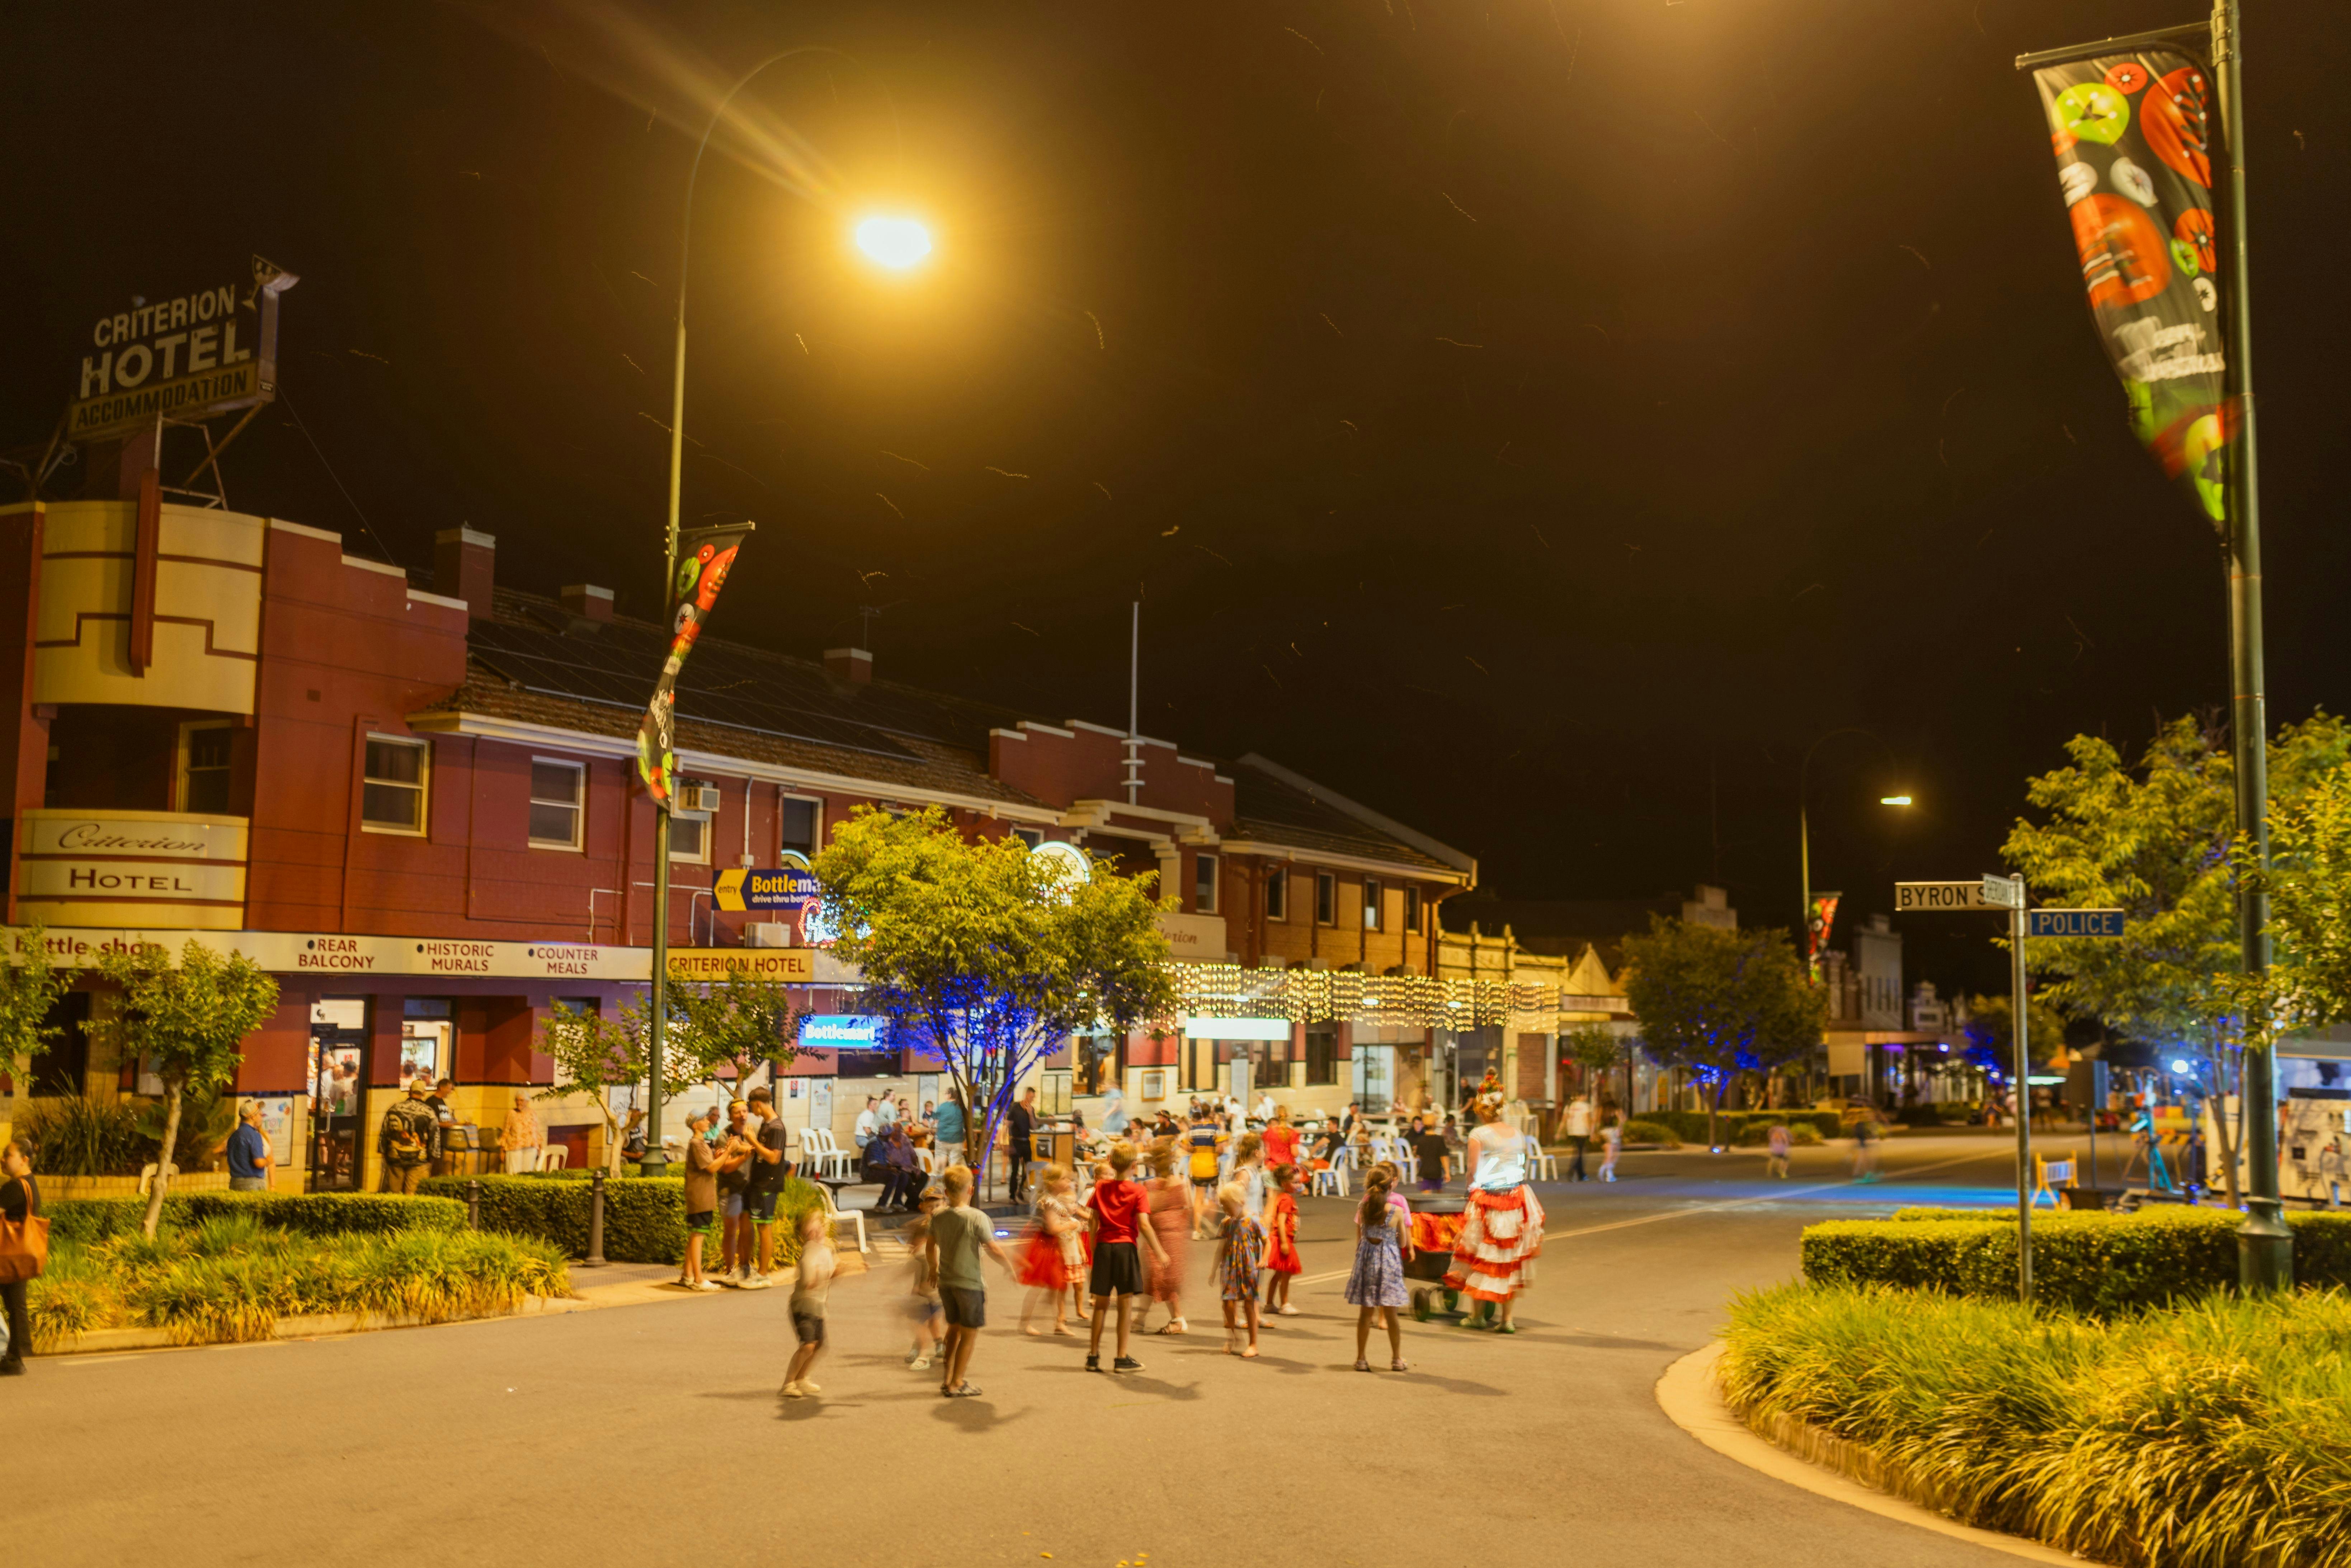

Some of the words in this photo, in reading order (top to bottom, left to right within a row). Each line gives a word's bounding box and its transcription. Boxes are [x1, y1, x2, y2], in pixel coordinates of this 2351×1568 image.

[94, 284, 235, 347] CRITERION
[80, 320, 250, 399] HOTEL
[76, 369, 248, 428] ACCOMMODATION
[58, 824, 205, 851] Criterion
[70, 869, 193, 891] HOTEL
[719, 885, 738, 896] entry
[1902, 887, 1968, 907] BYRON
[1977, 886, 1985, 905] S
[752, 895, 772, 903] drive
[773, 895, 789, 903] thru
[2039, 914, 2114, 933] POLICE
[15, 936, 87, 955] bttle
[318, 939, 357, 953] REAR
[427, 943, 494, 957] HISTORIC
[298, 954, 375, 969] BALCONY
[537, 947, 598, 961] COUNTER
[432, 958, 489, 972] MURALS
[547, 962, 588, 975] MEALS
[669, 957, 749, 973] CRITERION
[755, 958, 806, 973] HOTEL
[805, 1024, 875, 1040] Bottlemart
